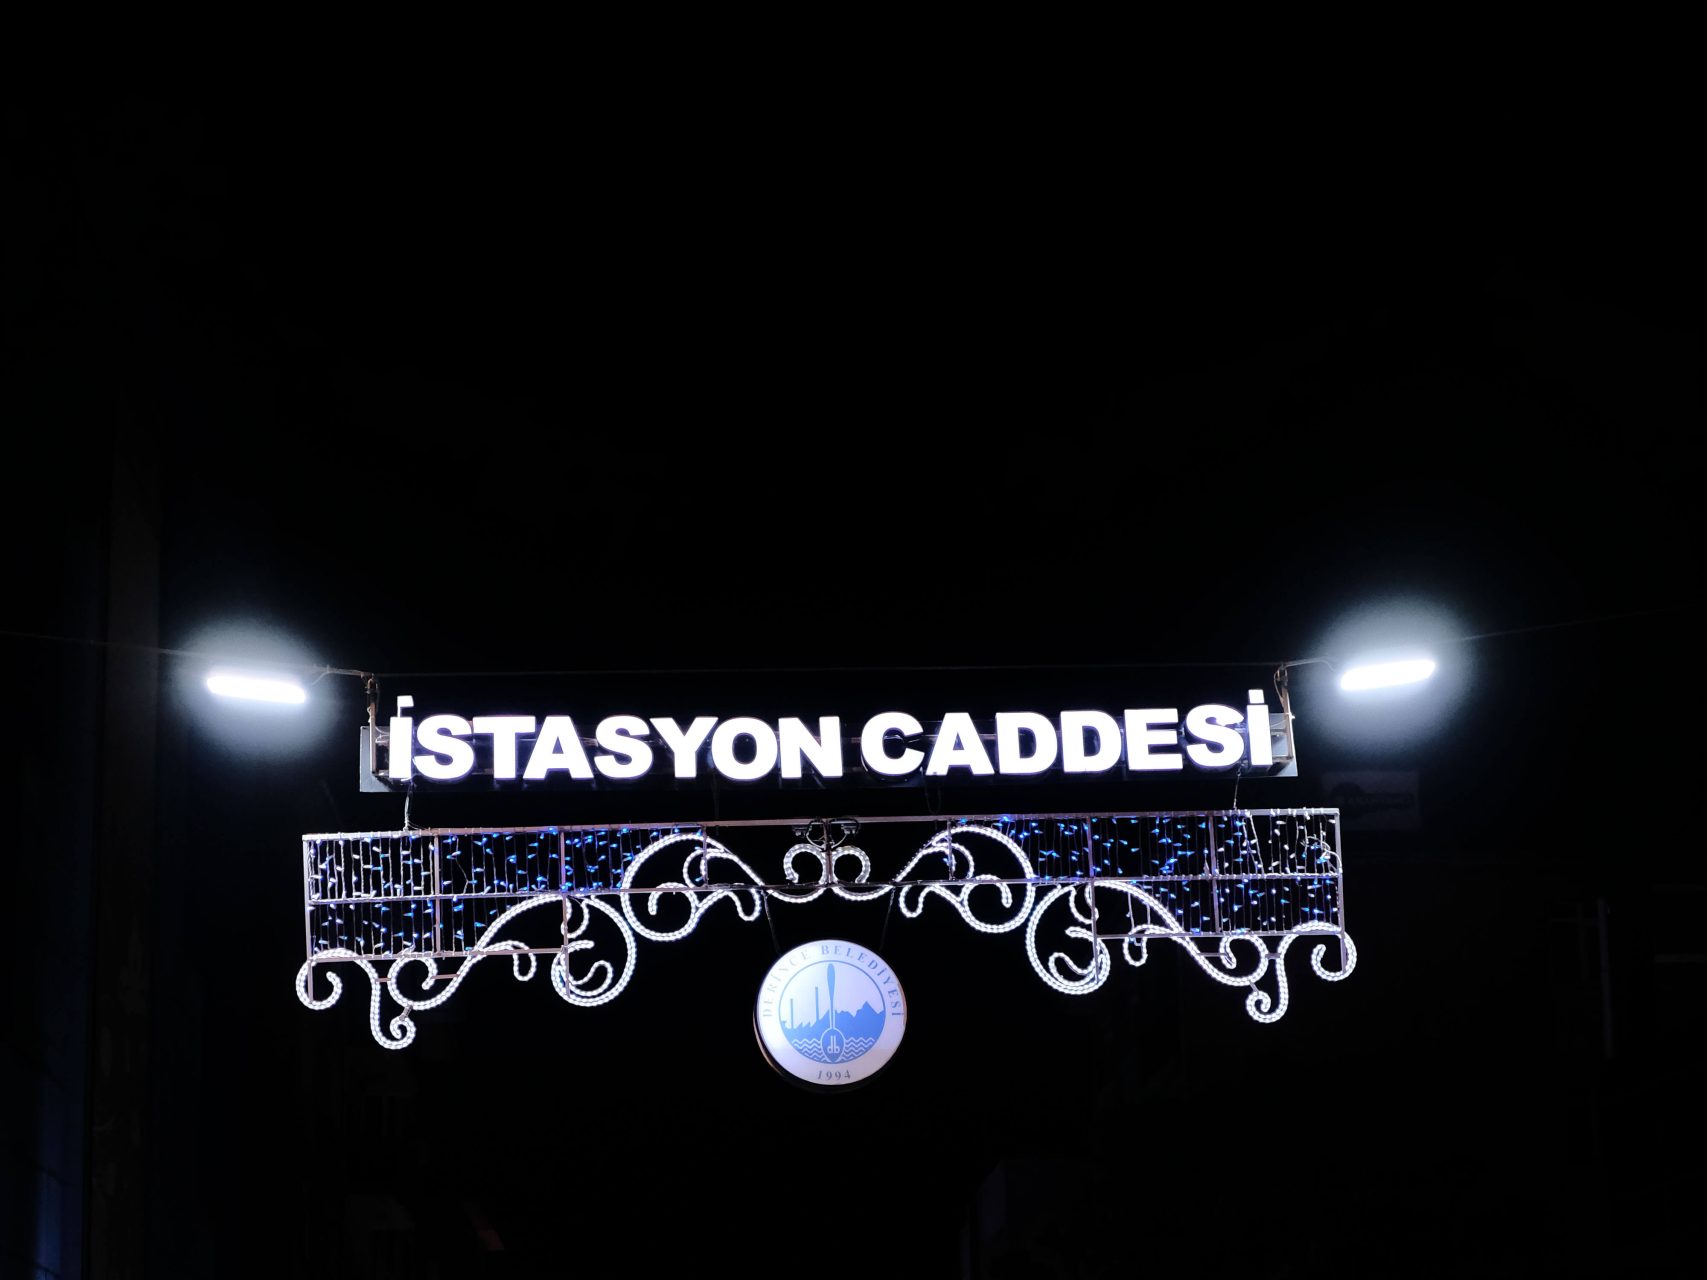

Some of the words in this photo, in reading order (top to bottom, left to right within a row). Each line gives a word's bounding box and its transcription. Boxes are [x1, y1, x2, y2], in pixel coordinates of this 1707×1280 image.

[389, 695, 844, 780] İSTASYON
[861, 689, 1273, 777] CADDESİ
[817, 1069, 851, 1080] 1994
